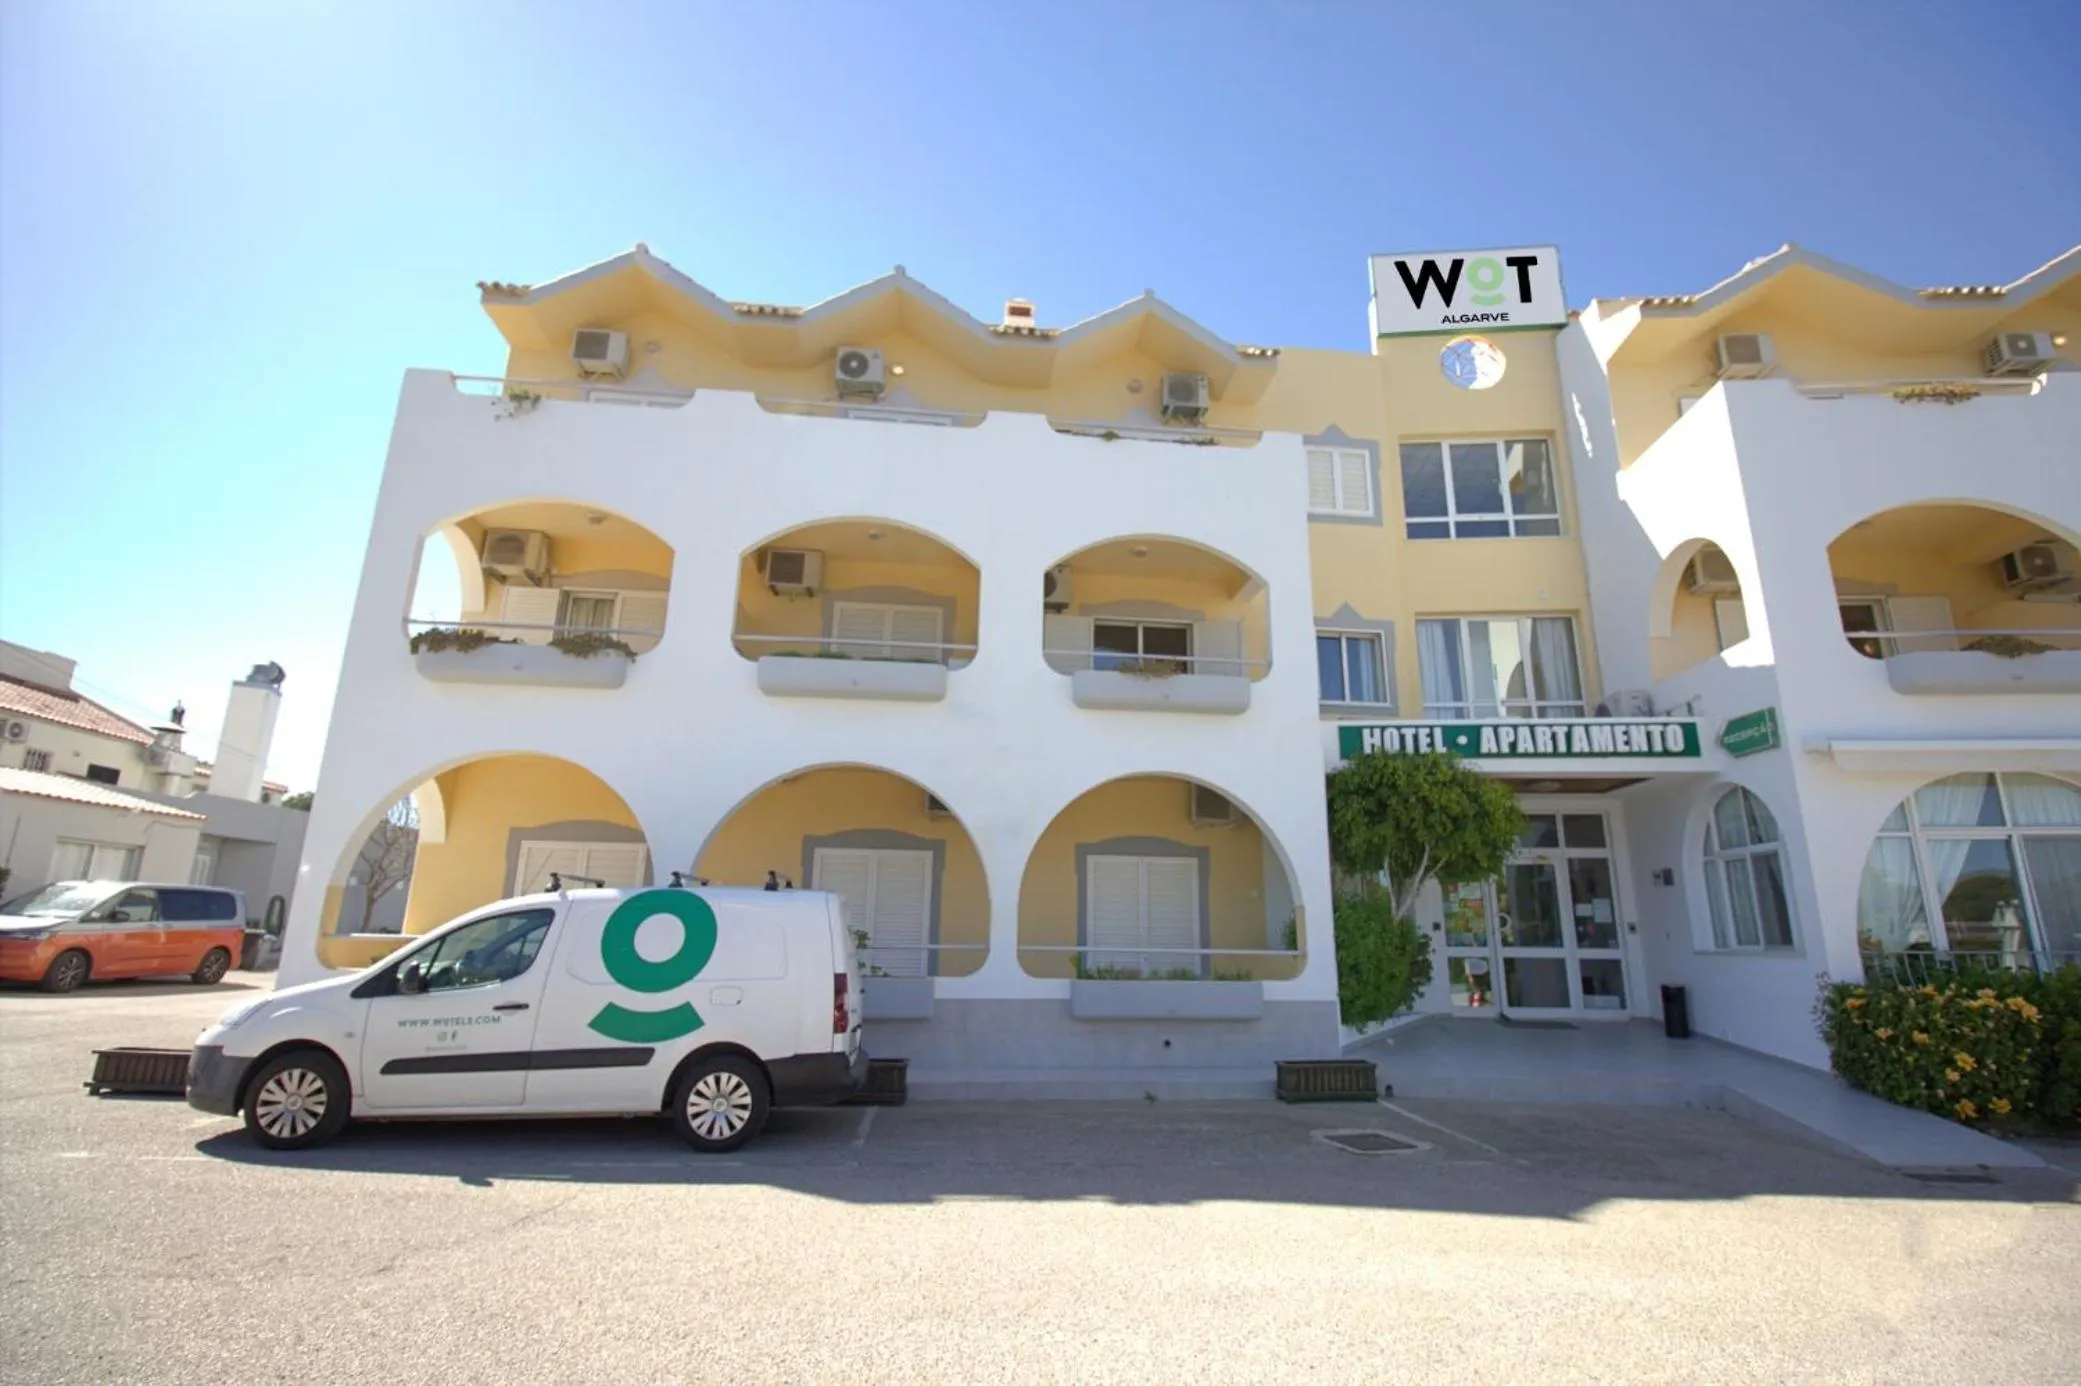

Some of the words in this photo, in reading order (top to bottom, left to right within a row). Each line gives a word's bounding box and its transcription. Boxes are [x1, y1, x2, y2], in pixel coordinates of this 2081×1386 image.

[1394, 256, 1538, 309] WOT
[1440, 312, 1510, 324] ALGARVE
[1362, 727, 1447, 754] HOTEL
[1480, 724, 1685, 754] APARTAMENTO
